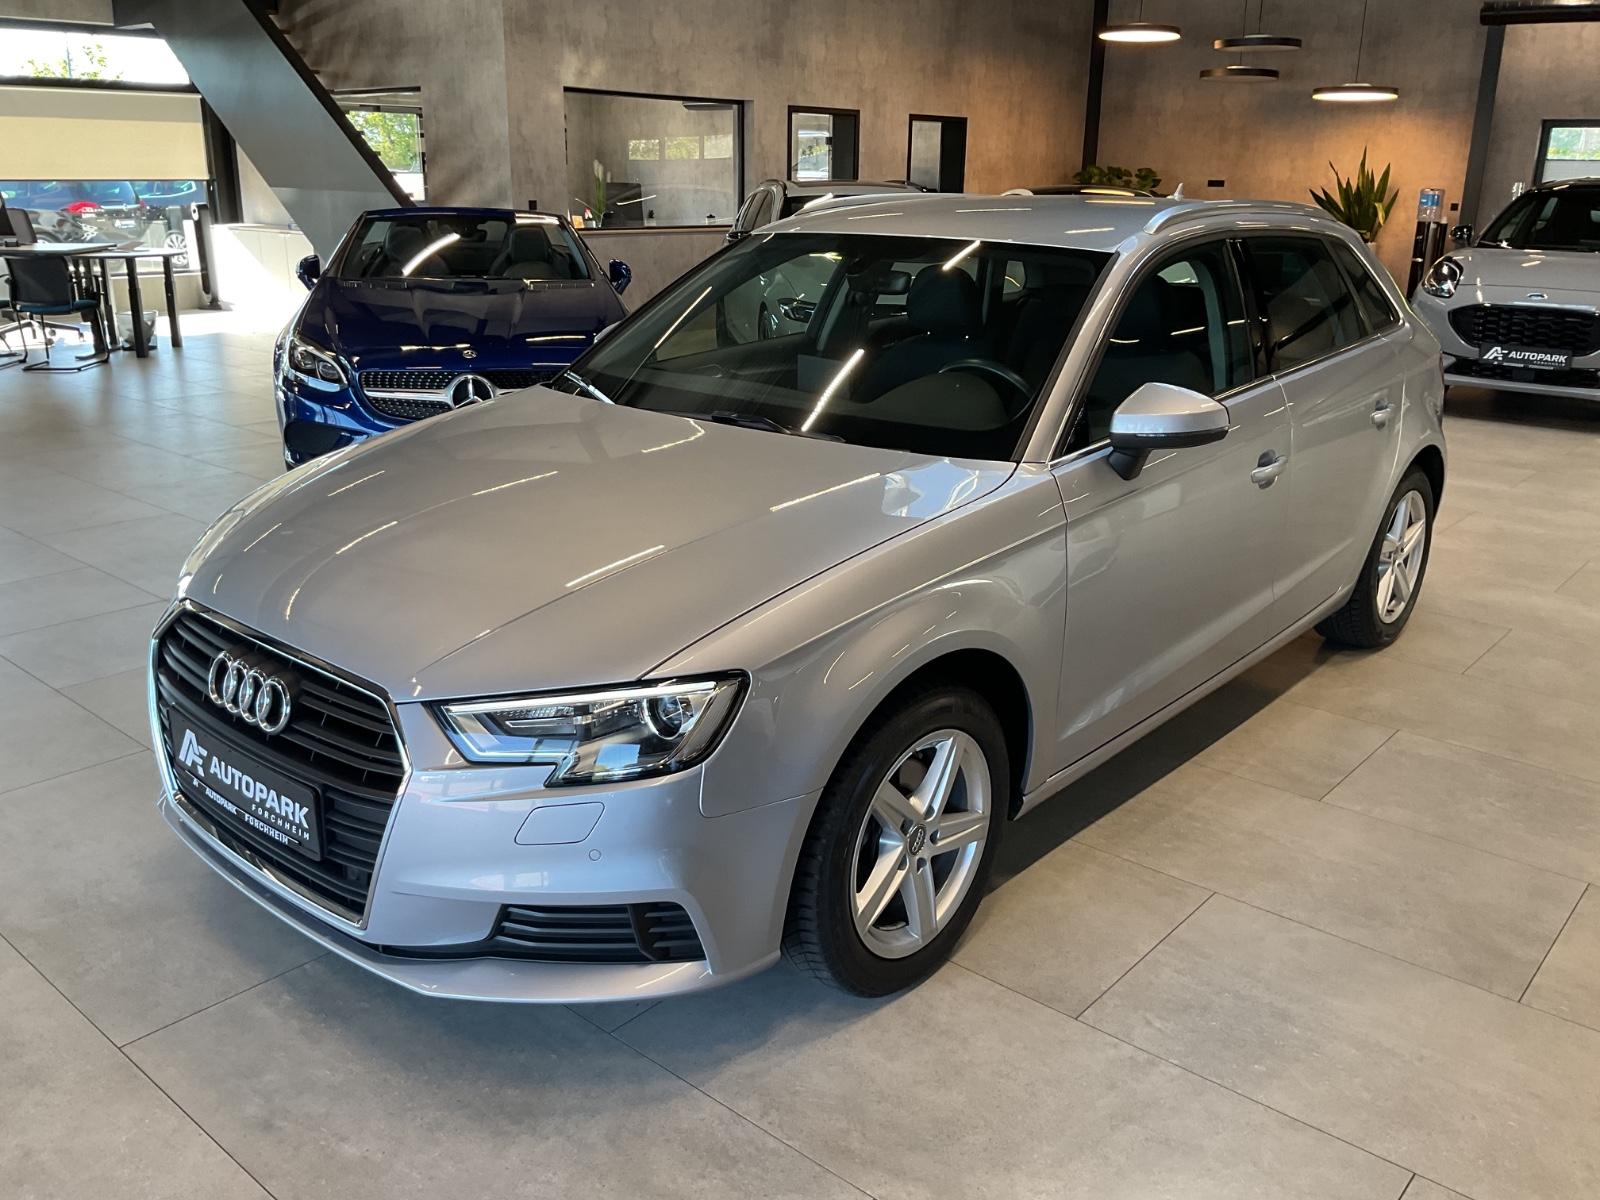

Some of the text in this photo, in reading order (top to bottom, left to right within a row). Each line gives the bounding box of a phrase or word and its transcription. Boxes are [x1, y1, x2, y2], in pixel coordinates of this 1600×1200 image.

[1508, 351, 1568, 363] AUTOPARK
[205, 787, 289, 845] AUTOPARK FORCHHEIM
[210, 756, 309, 829] AUTOPARK
[251, 803, 310, 841] FORCHHEIM
